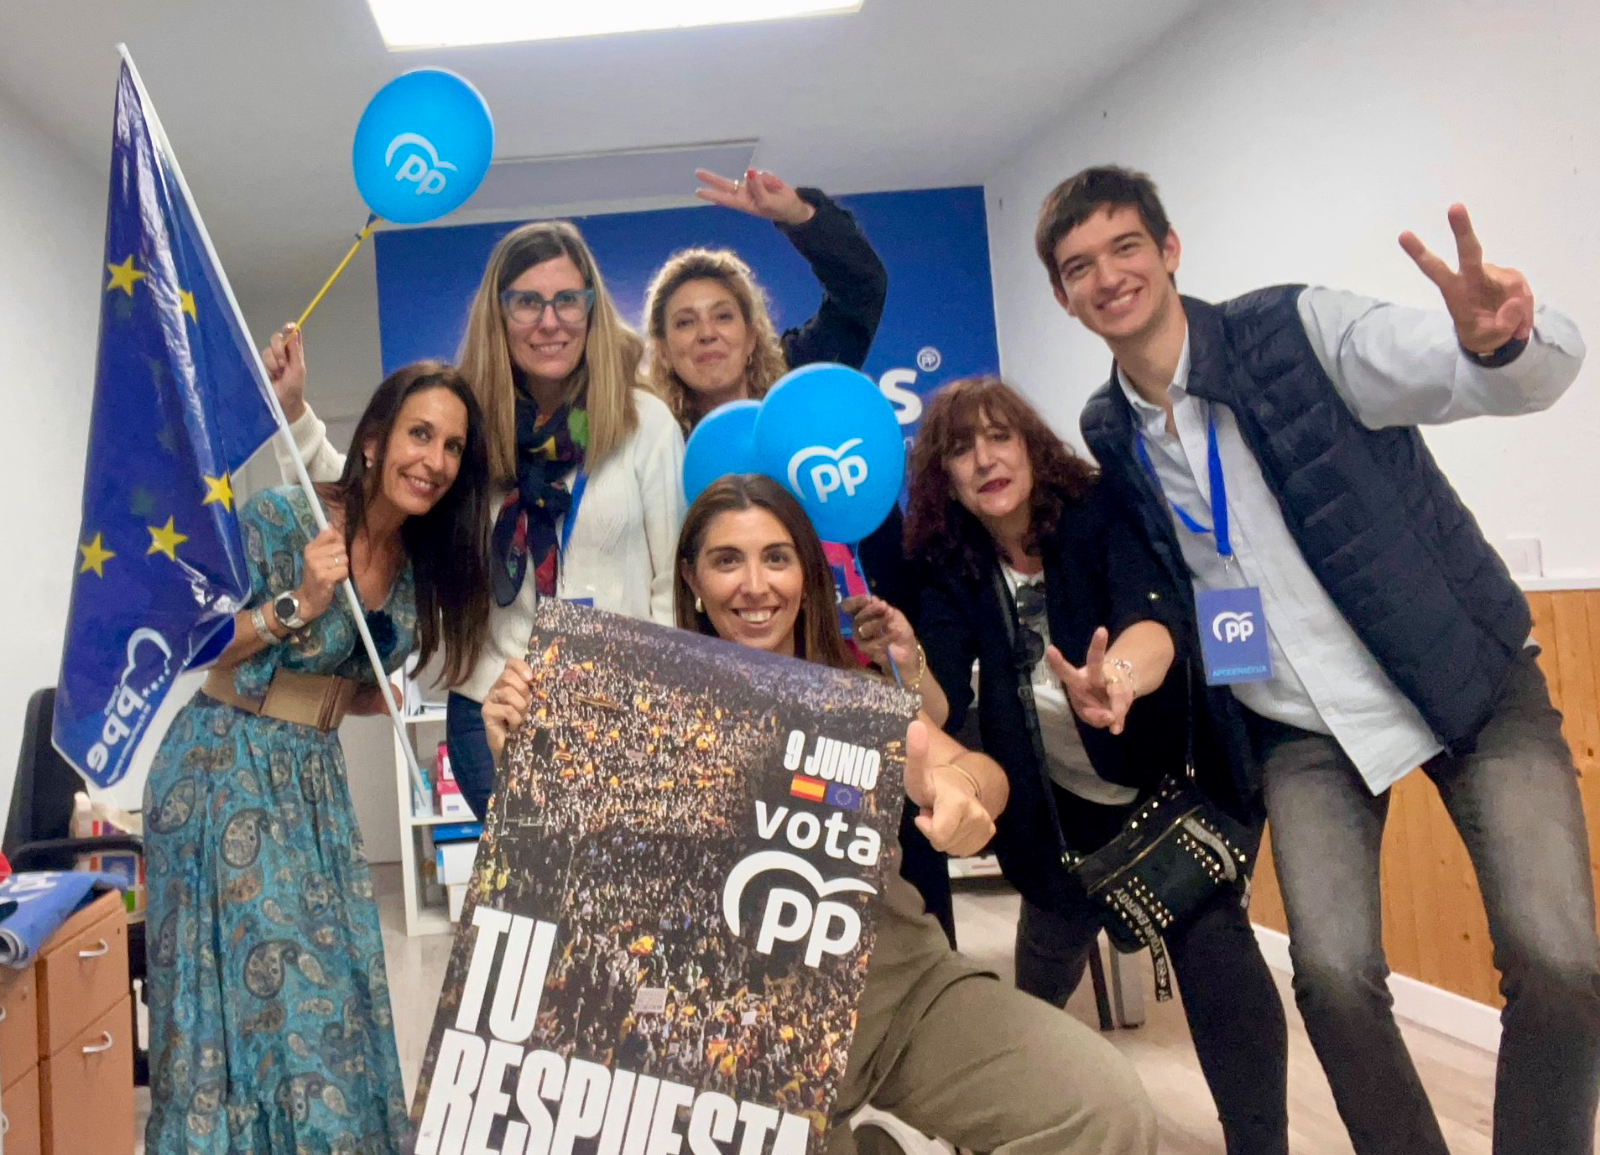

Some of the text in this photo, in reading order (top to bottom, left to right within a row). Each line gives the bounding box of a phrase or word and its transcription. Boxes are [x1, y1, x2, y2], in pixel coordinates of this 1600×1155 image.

[395, 153, 447, 195] pp
[810, 454, 868, 503] pp
[1225, 620, 1254, 643] pp
[783, 729, 881, 791] 9 JUNIO
[755, 800, 881, 866] vota
[756, 887, 862, 969] pp
[1113, 887, 1151, 926] ENERGY
[455, 905, 558, 1043] TU
